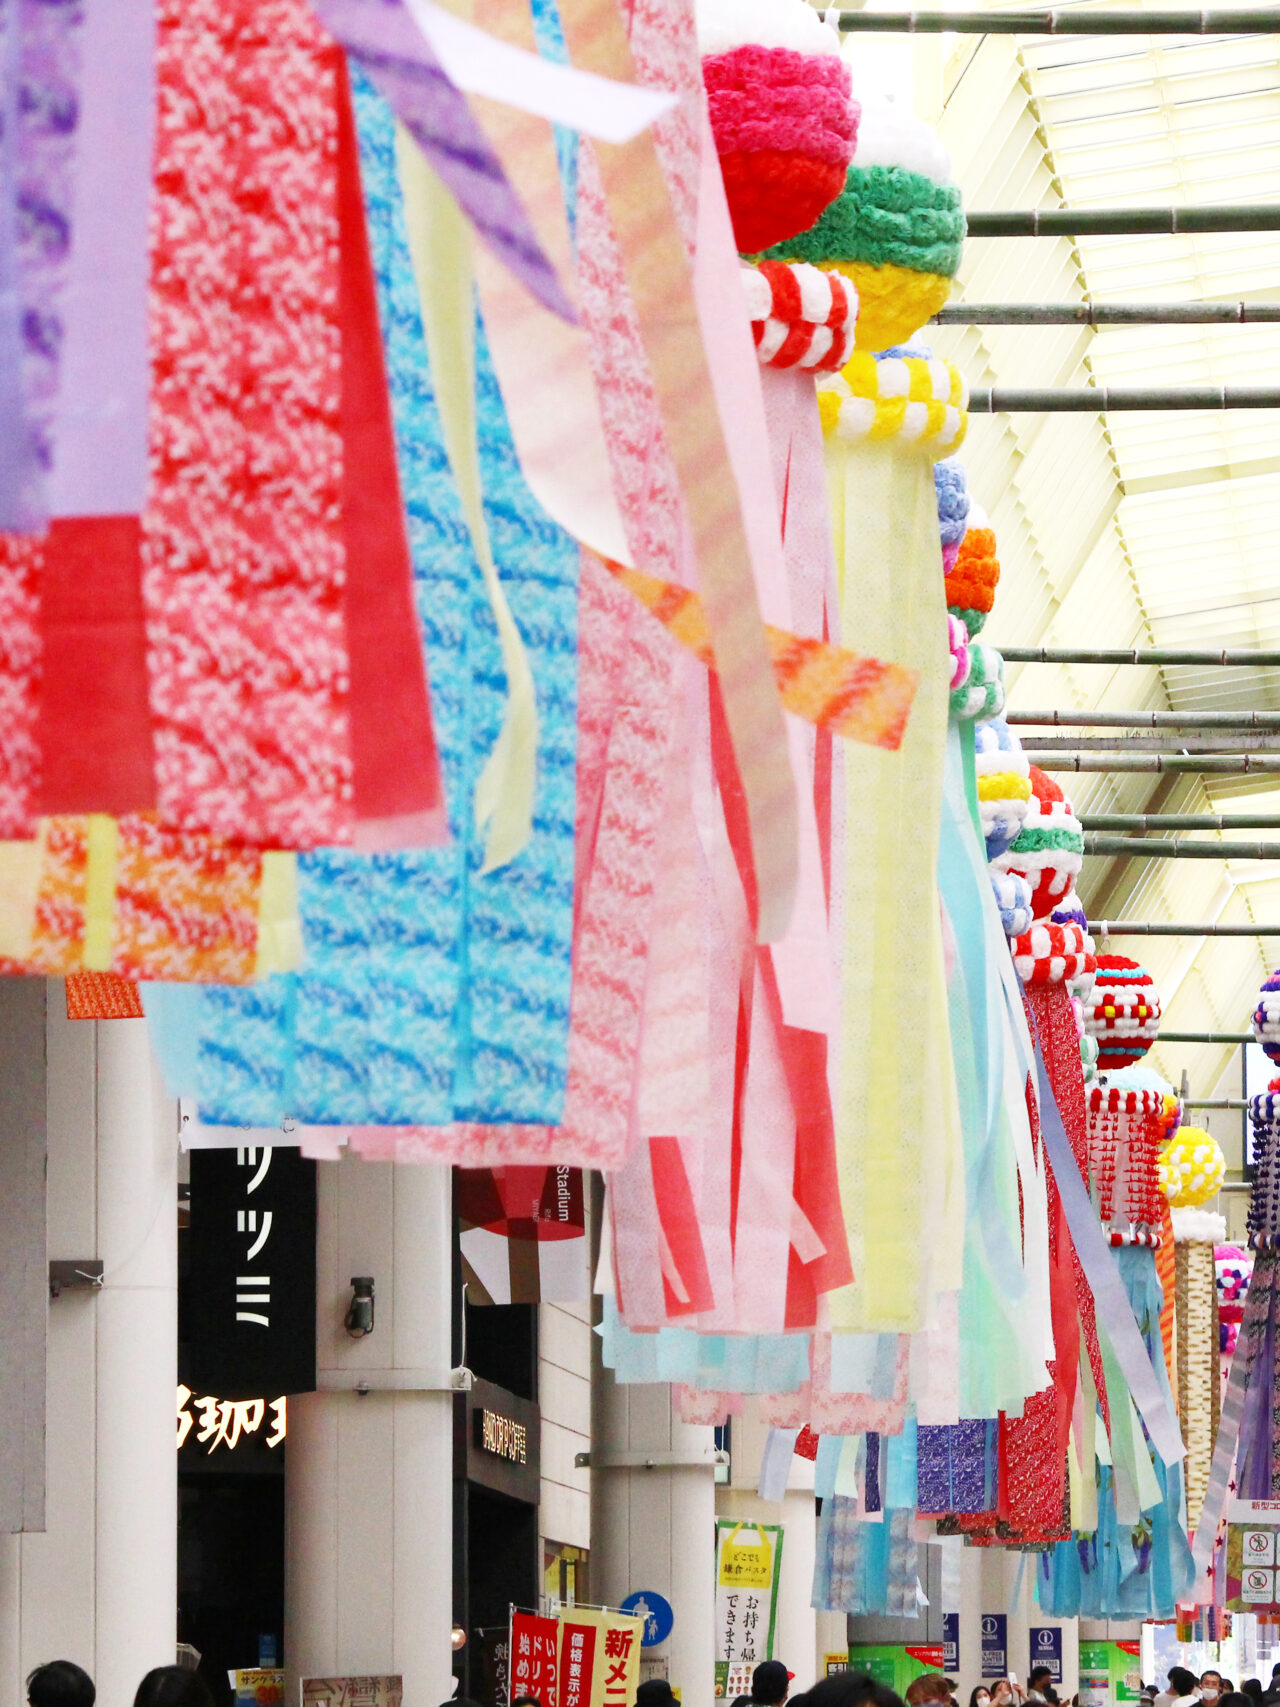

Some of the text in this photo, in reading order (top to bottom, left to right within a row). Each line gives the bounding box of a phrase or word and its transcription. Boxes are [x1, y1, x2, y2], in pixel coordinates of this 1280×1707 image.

[556, 1166, 571, 1222] Stadium
[723, 1594, 740, 1661] できます
[566, 1632, 585, 1707] 価格表示が
